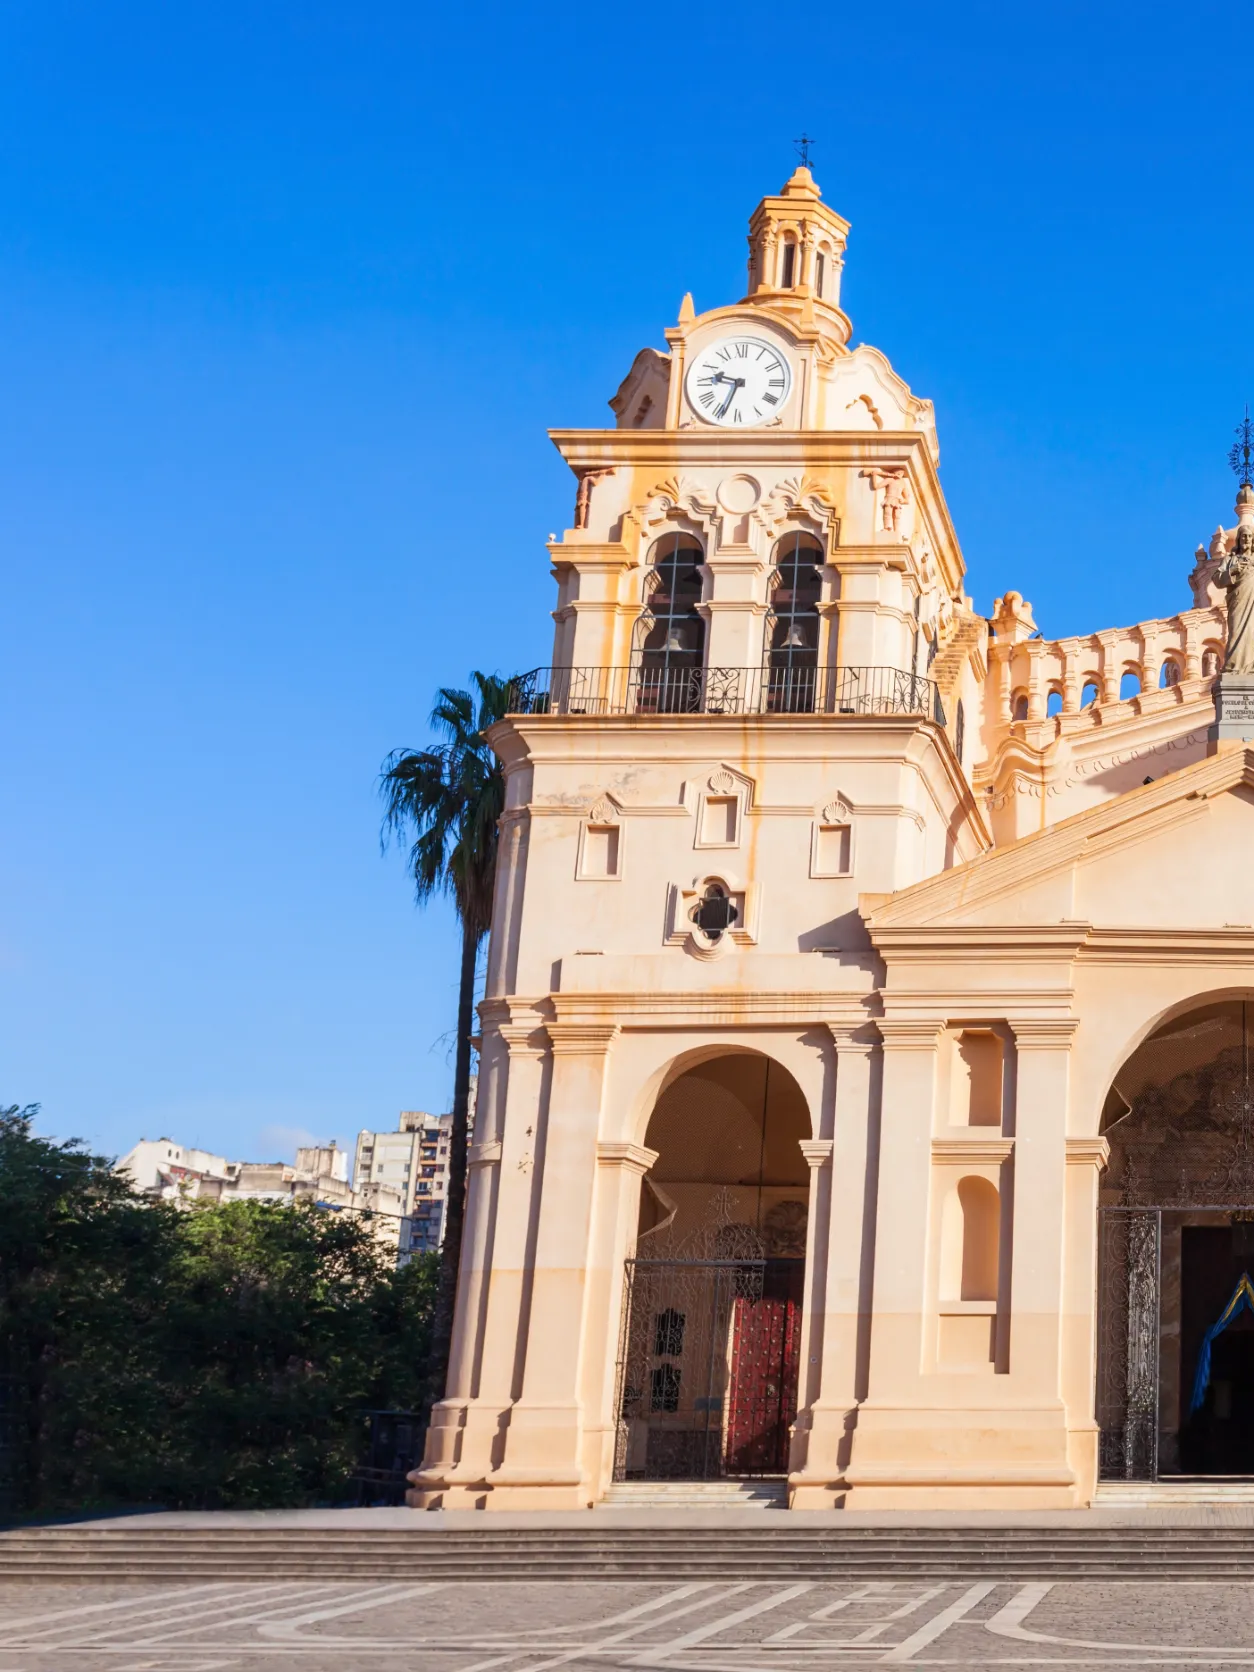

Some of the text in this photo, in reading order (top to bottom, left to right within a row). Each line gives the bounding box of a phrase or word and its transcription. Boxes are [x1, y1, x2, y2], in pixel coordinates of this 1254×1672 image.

[734, 344, 748, 358] XII
[755, 348, 766, 361] I
[764, 361, 781, 373] II
[768, 379, 784, 387] III
